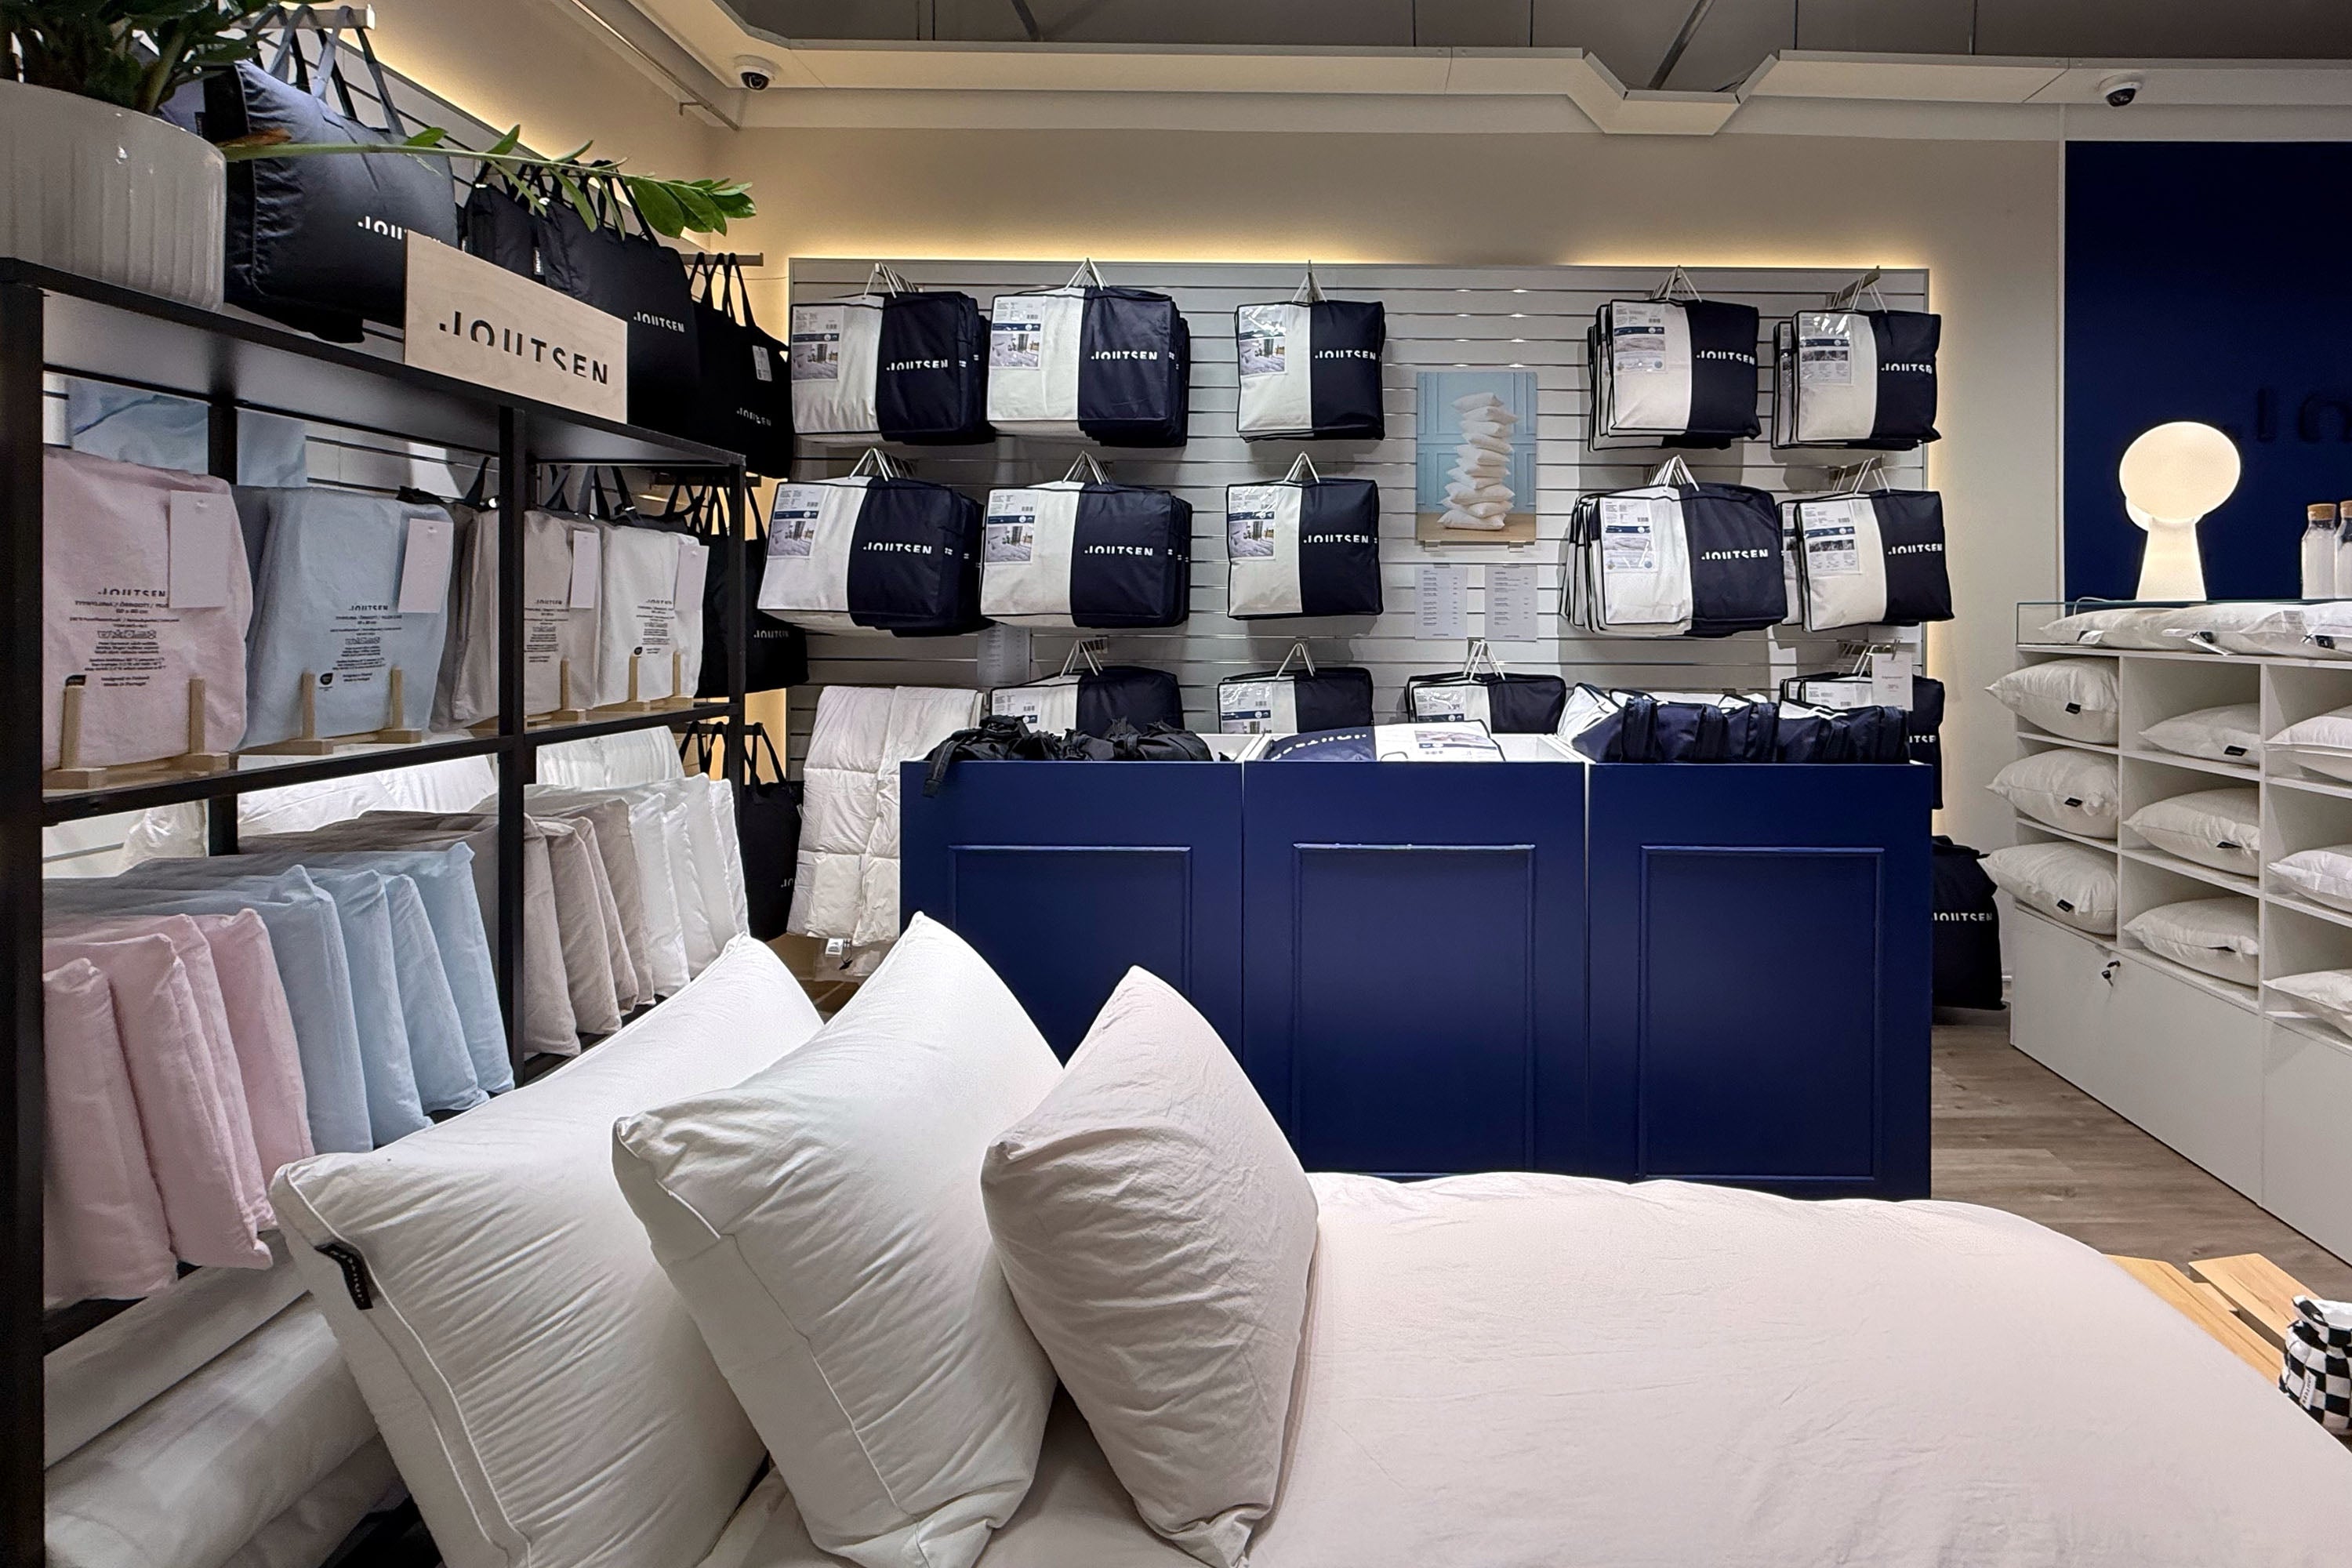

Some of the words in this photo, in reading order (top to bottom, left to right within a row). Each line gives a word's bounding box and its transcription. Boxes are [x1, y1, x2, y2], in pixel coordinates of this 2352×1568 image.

[633, 311, 684, 332] JOUTSEN
[439, 310, 608, 385] JOUTSEN
[1091, 350, 1158, 360] JOUTSEN
[1315, 350, 1376, 360] JOUTSEN
[1696, 350, 1755, 365] JOUTSEN
[886, 359, 949, 371] JOUTSEN
[1303, 534, 1369, 543] JOUTSEN
[862, 542, 932, 554] JOUTSEN
[1084, 545, 1153, 556] JOUTSEN
[1888, 543, 1943, 555] JOUTSEN
[1700, 549, 1769, 560] JOUTSEN
